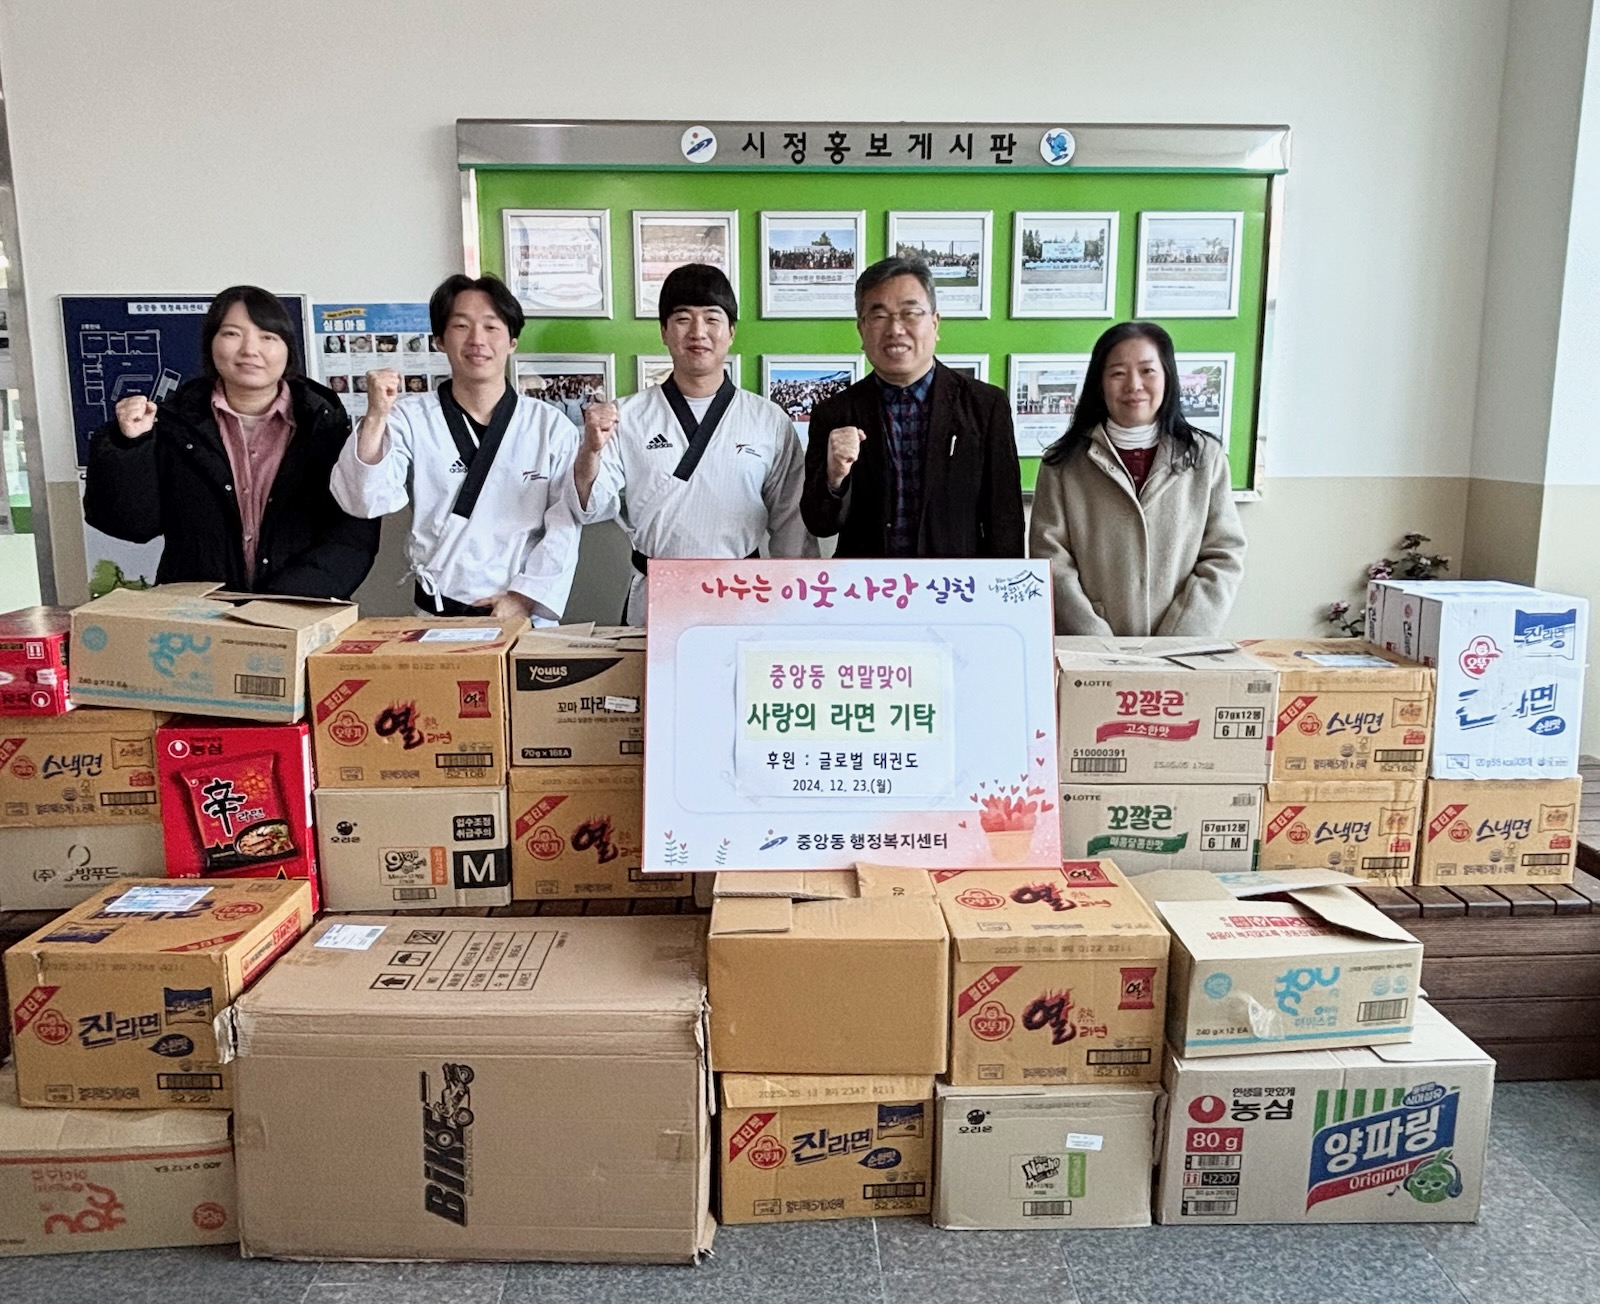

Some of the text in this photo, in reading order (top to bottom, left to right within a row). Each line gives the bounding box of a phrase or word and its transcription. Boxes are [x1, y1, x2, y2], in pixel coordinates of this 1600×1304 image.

[741, 131, 1017, 164] 시정홍보게시판
[646, 441, 674, 450] adidas
[701, 574, 772, 603] 나누는
[781, 571, 837, 608] 이웃
[844, 573, 919, 609] 사랑
[926, 576, 976, 603] 실천
[1524, 625, 1566, 644] 진라면
[529, 665, 568, 681] youus
[770, 664, 913, 690] 중앙동 연말맞이
[557, 701, 577, 713] 꼬마
[1115, 690, 1185, 717] 꼬깔콘
[747, 702, 936, 734] 사랑의 라면 기탁
[1326, 712, 1384, 736] 스낵면
[1536, 718, 1561, 733] 순한맛
[1124, 723, 1170, 738] 고소한맛
[1221, 725, 1256, 737] 6 M
[189, 742, 223, 756] 농심
[42, 753, 103, 779] 스낵면
[766, 751, 796, 771] 후원
[818, 751, 864, 771] 글로벌
[873, 751, 920, 770] 태권도
[792, 779, 824, 793] 2024.
[830, 779, 848, 793] 12.
[201, 777, 248, 838] 辛
[236, 807, 266, 822] 라면
[1107, 804, 1173, 831] 꼬깔콘
[330, 836, 361, 844] 오리온
[1315, 821, 1371, 844] 스낵면
[1476, 818, 1532, 842] 스낵면
[797, 832, 948, 851] 중앙동 행정복지센터
[1208, 837, 1241, 849] 6 M
[33, 868, 56, 882] (주)
[462, 853, 496, 884] M
[78, 1011, 162, 1049] 진라면
[1232, 1086, 1296, 1097] 인생을 맛있게
[1230, 1098, 1295, 1122] 농심
[958, 1125, 993, 1133] 오리온
[1324, 1105, 1441, 1173] 양파링
[790, 1127, 874, 1165] 진라면
[1192, 1131, 1239, 1151] 80 g
[753, 1151, 781, 1163] 오뚜기
[867, 1151, 896, 1166] 순한맛
[1024, 1157, 1061, 1179] Nacho
[1349, 1164, 1410, 1191] Original
